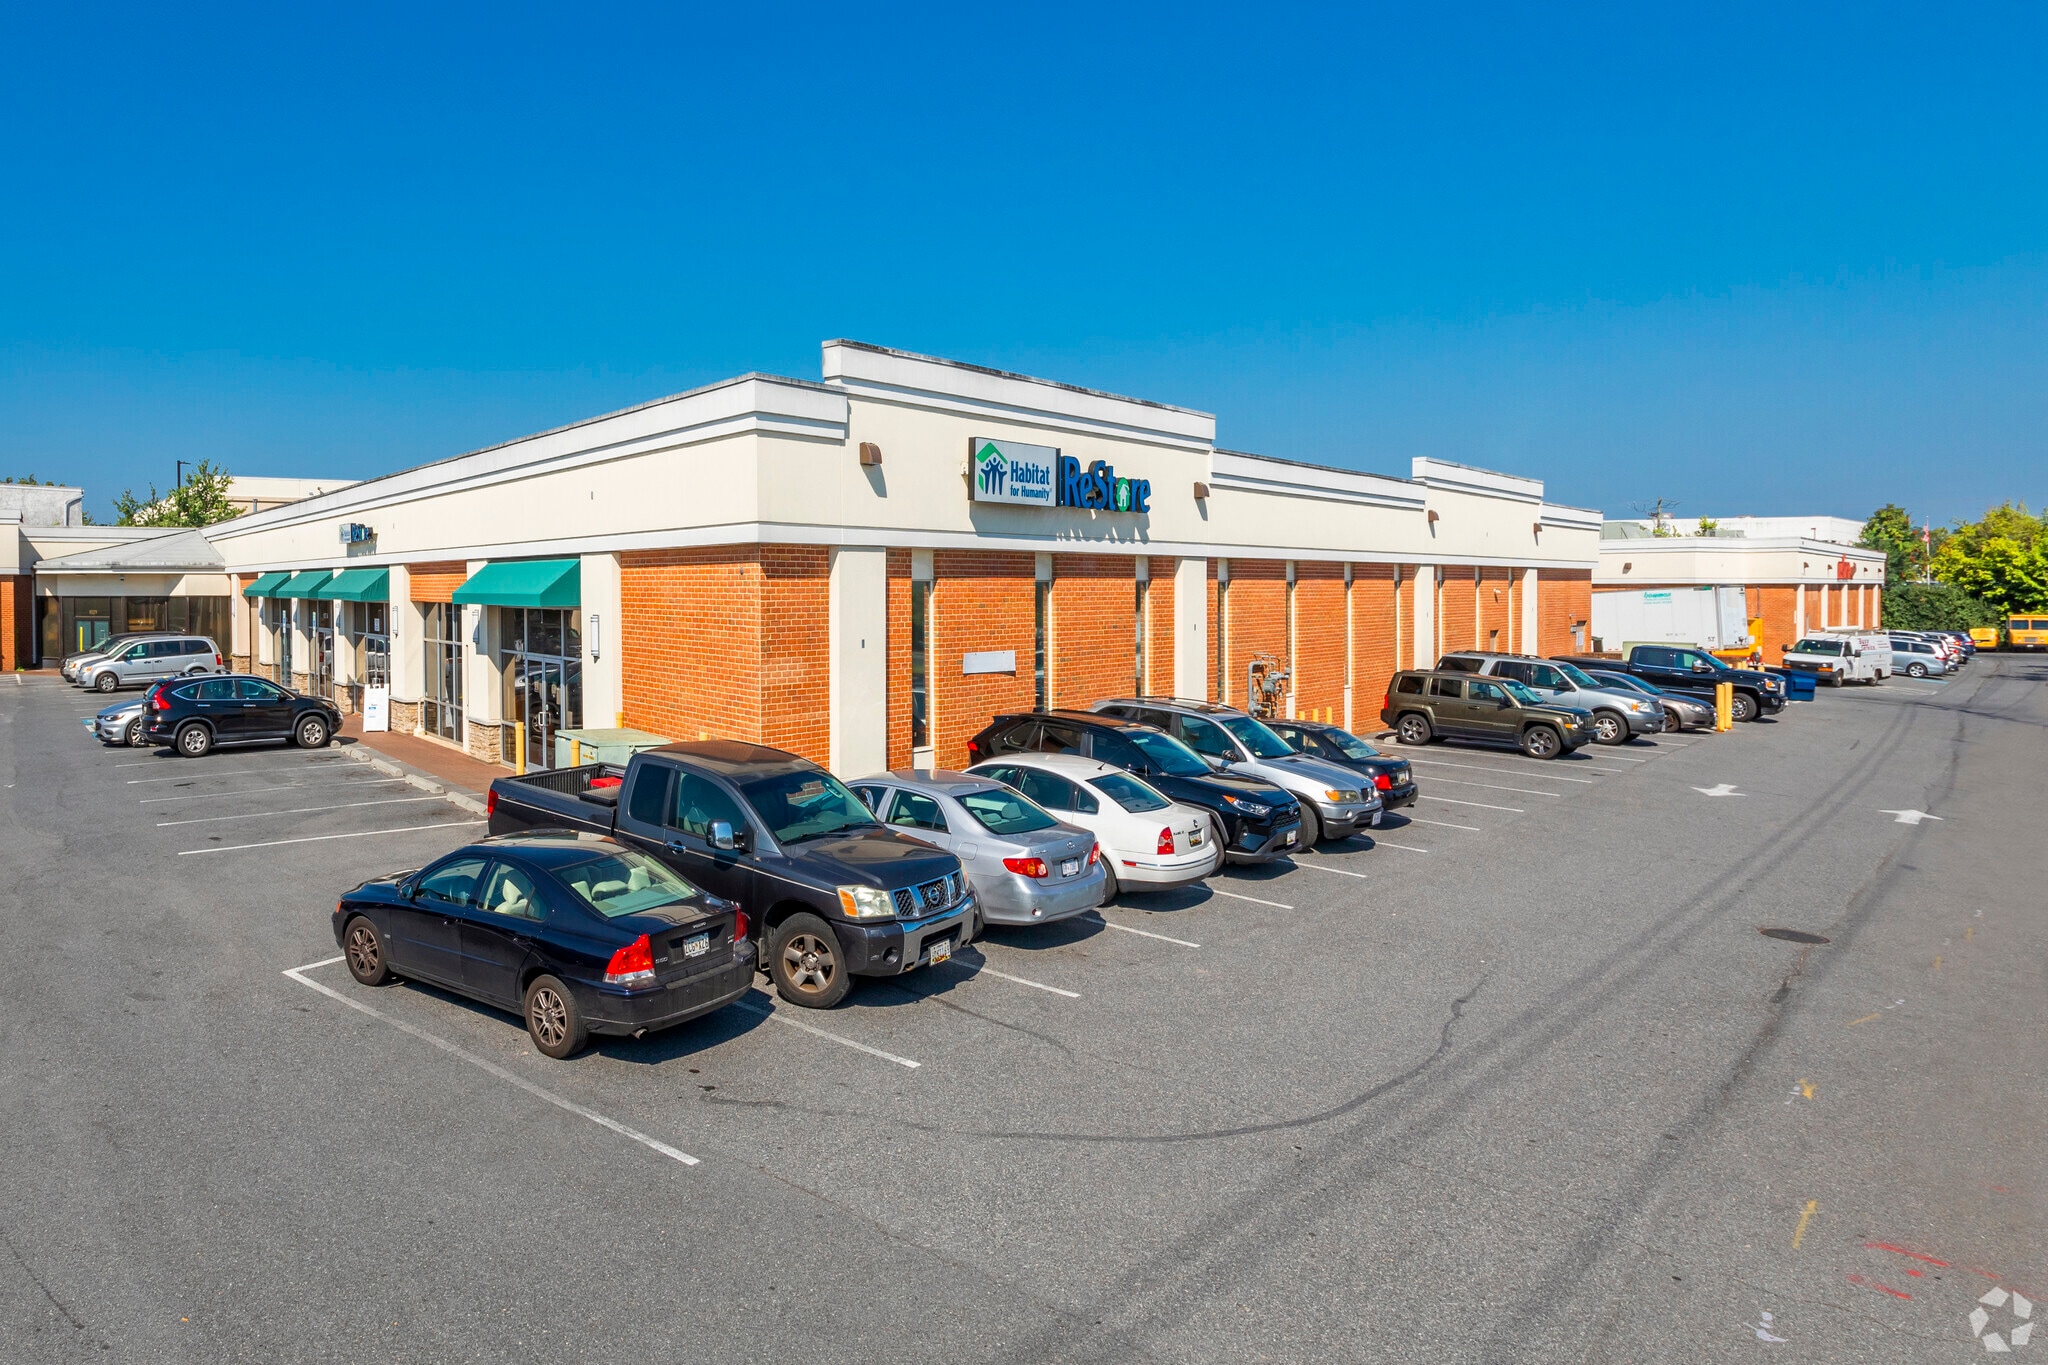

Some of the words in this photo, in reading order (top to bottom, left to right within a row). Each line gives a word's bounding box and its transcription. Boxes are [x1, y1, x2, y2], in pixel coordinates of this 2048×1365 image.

[1010, 460, 1050, 486] Habitat
[1063, 455, 1152, 513] ReStore
[1010, 484, 1019, 496] for
[1021, 485, 1050, 502] Humanity
